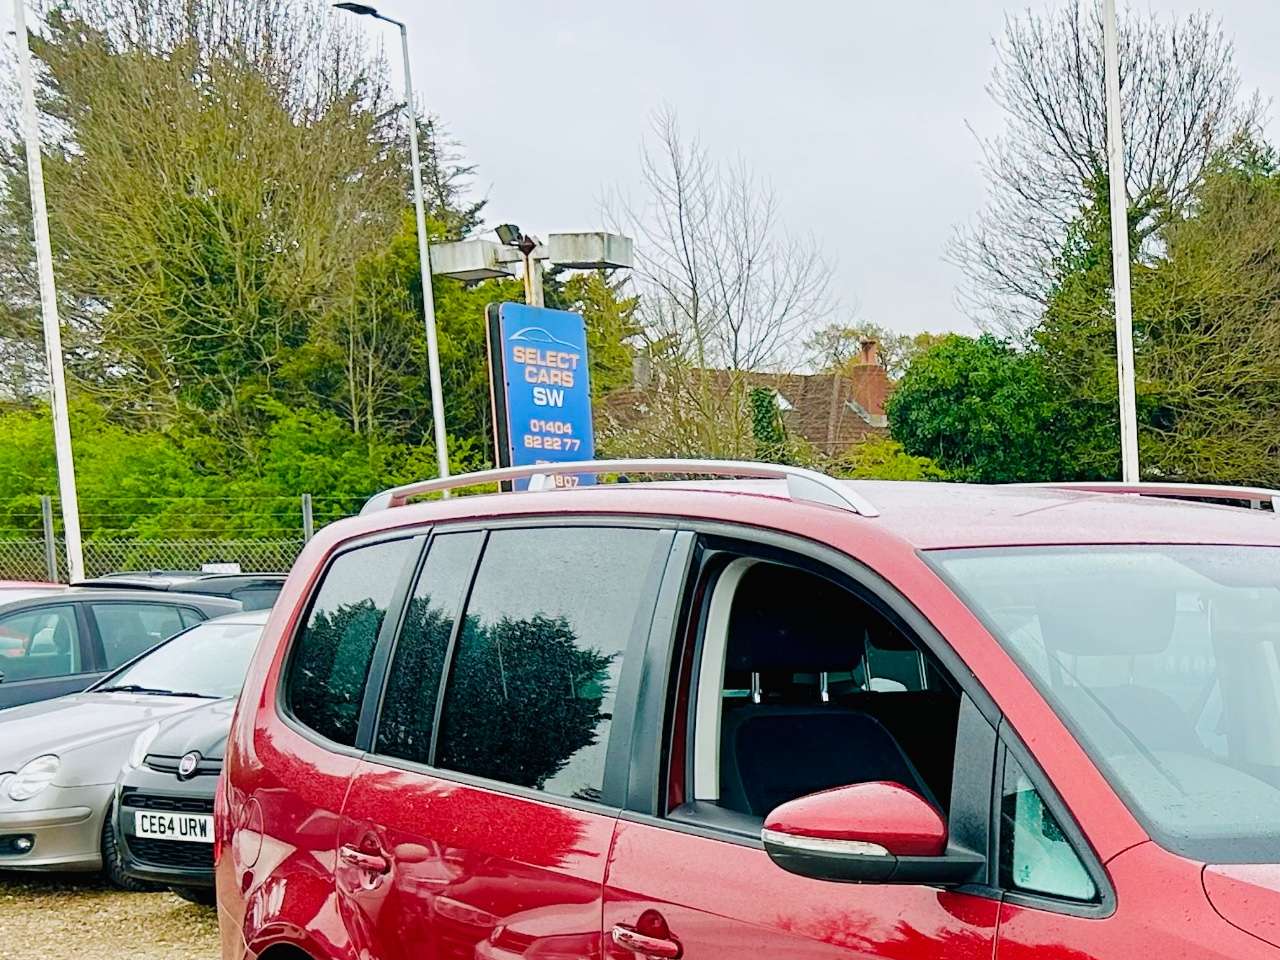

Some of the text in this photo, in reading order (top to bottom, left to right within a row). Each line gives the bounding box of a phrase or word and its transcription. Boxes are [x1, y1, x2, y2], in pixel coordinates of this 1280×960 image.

[512, 346, 580, 370] SELECT
[525, 366, 574, 388] CARS
[533, 387, 564, 407] SW
[530, 419, 572, 435] 01404
[141, 815, 208, 838] CE64 URW
